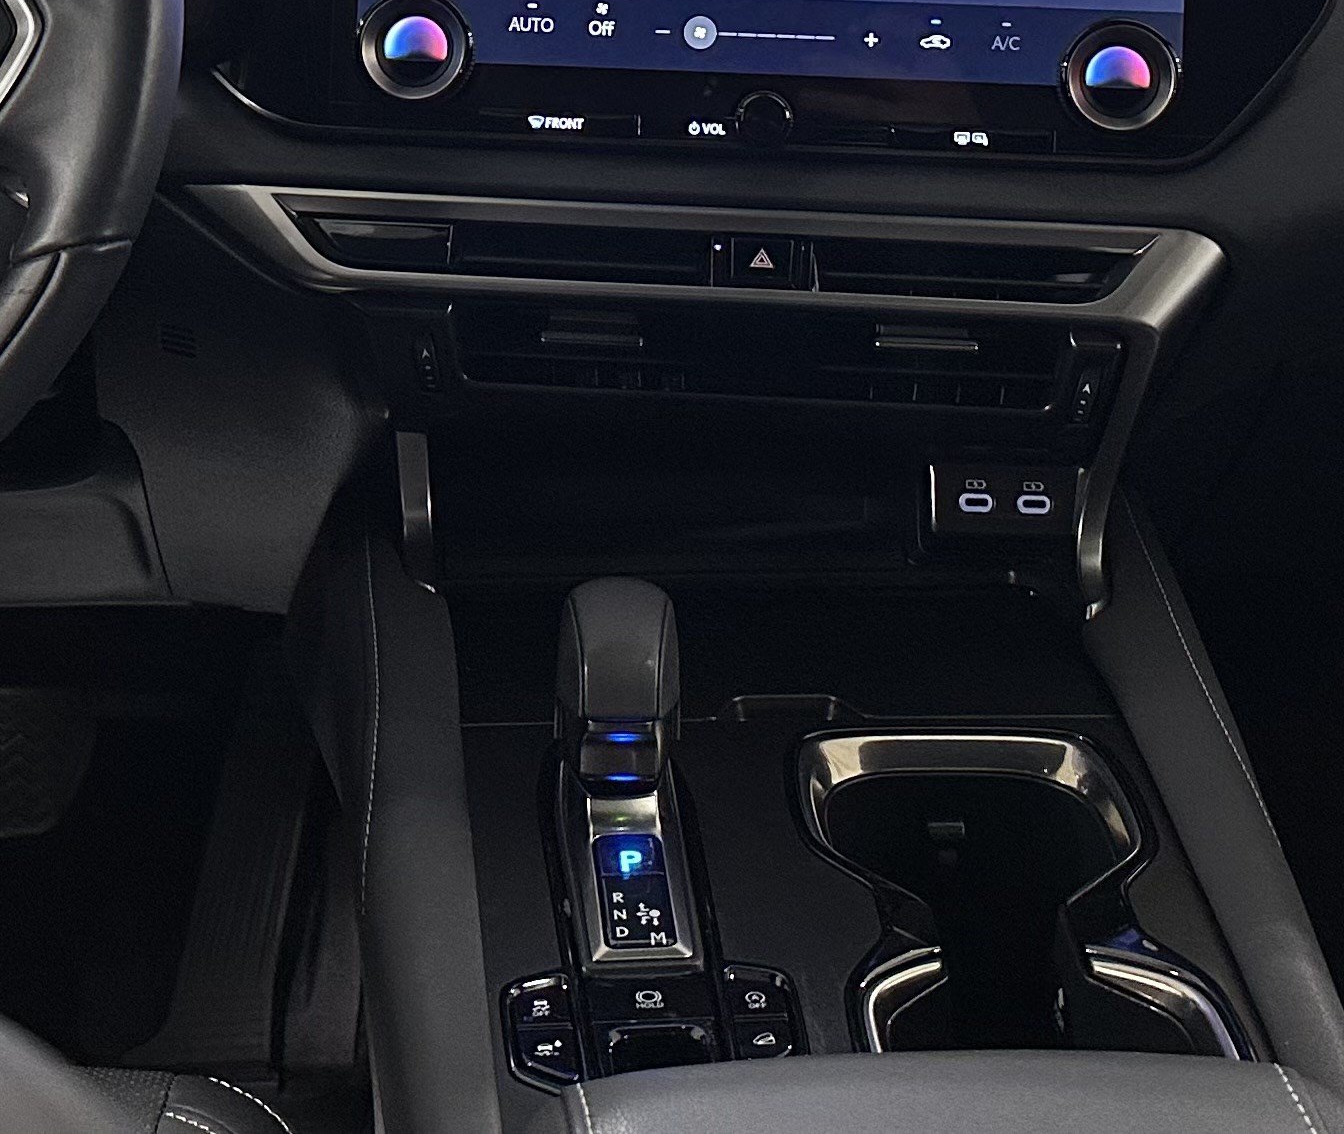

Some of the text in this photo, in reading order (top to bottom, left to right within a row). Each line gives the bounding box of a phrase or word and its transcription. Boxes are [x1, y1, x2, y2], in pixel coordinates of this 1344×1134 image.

[508, 17, 554, 34] AUTO
[588, 18, 615, 37] Off
[991, 35, 1021, 52] A/C
[545, 116, 585, 130] FRONT
[702, 123, 726, 136] VOL
[619, 851, 642, 872] P
[612, 892, 624, 903] R
[614, 909, 627, 920] N
[616, 926, 629, 938] D
[650, 932, 667, 946] M
